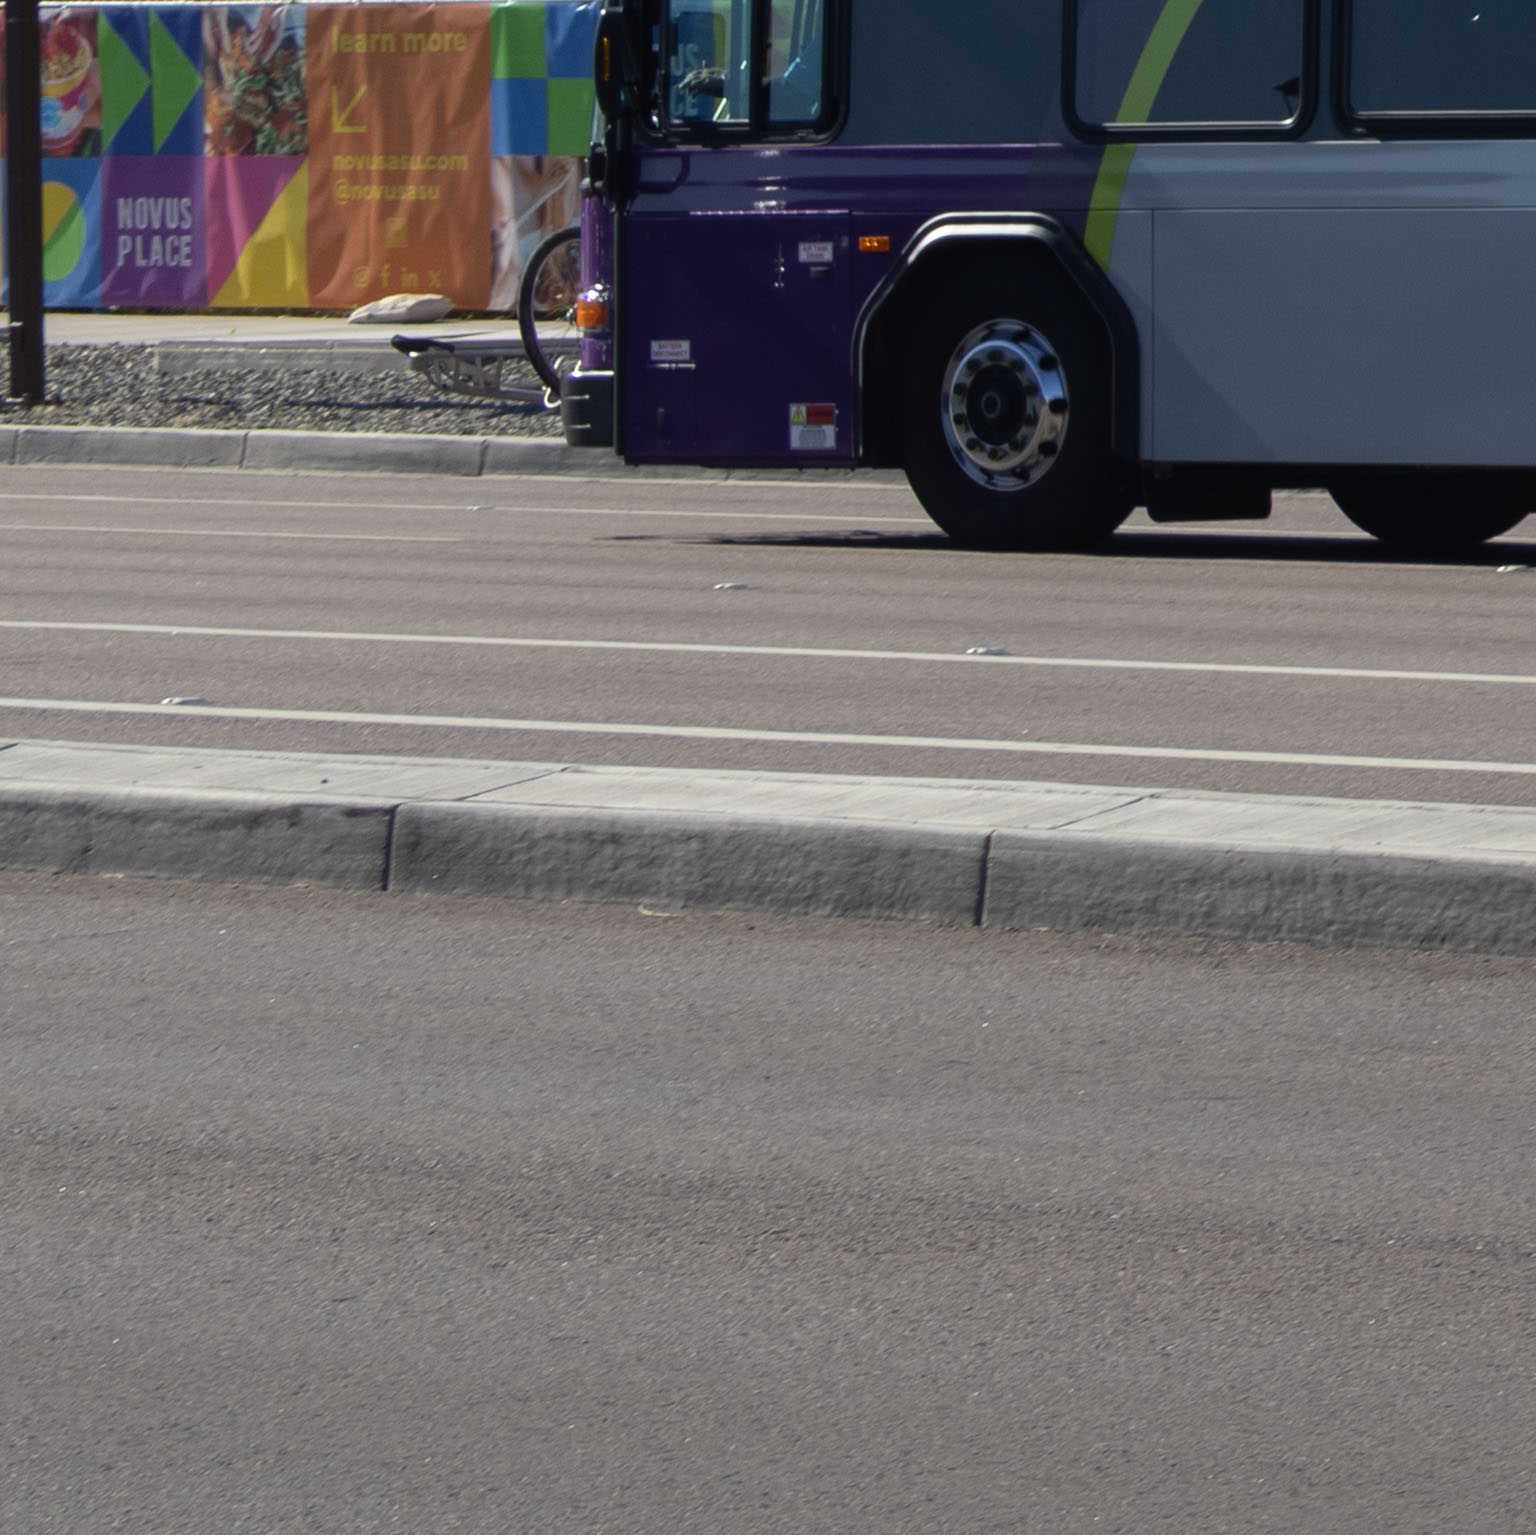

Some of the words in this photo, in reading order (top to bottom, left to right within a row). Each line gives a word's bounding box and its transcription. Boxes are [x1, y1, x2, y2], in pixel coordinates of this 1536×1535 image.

[331, 25, 396, 54] learn
[403, 31, 468, 54] more
[117, 196, 193, 230] NOVUS
[118, 234, 193, 267] PLACE
